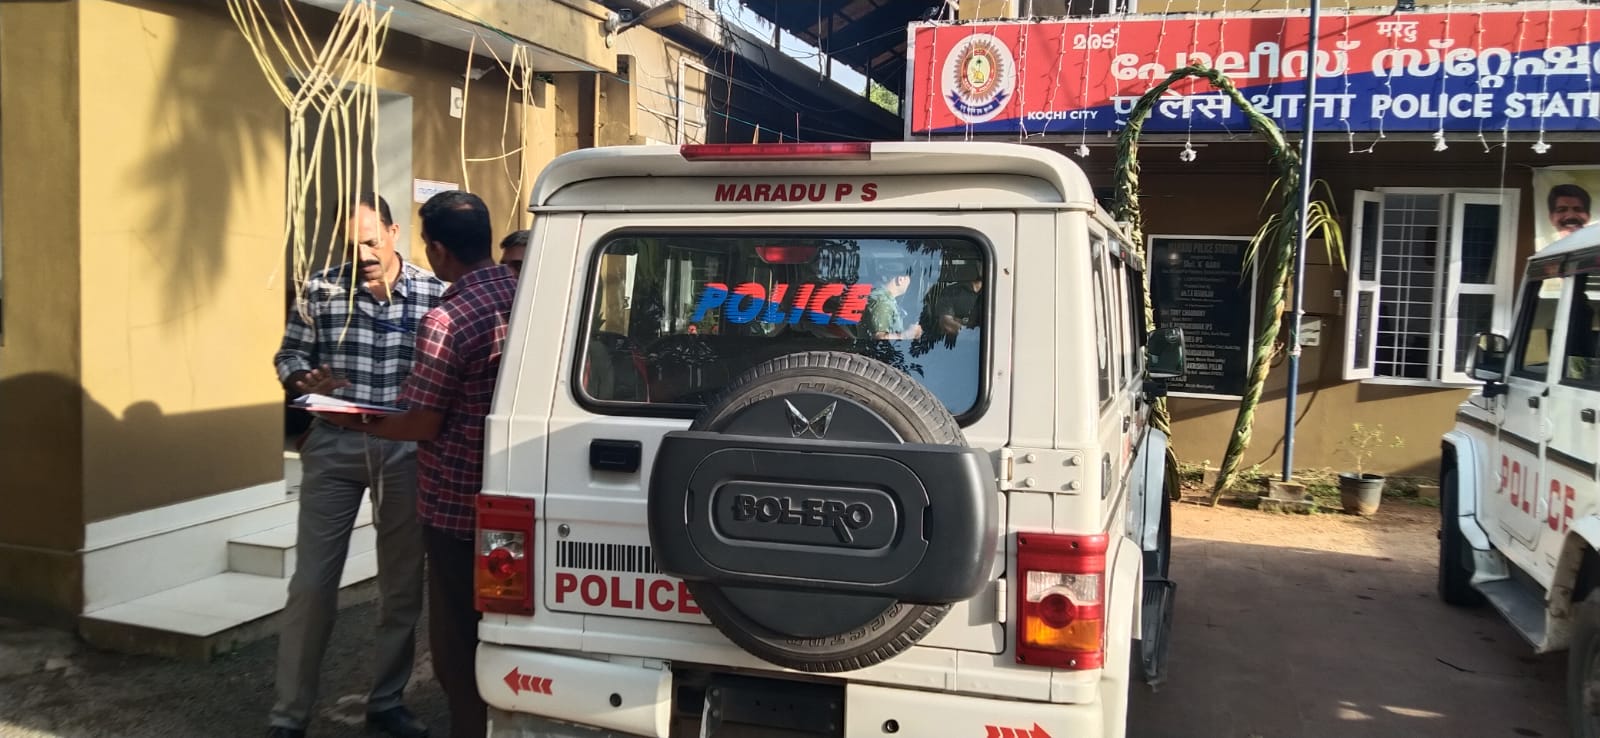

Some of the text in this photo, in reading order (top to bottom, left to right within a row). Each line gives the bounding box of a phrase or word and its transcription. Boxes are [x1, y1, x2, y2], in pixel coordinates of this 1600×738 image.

[1072, 29, 1119, 50] മരട്
[1376, 20, 1419, 43] मरदु
[1371, 38, 1600, 89] സ്റ്റേഷ
[1027, 109, 1099, 121] KOCHI CITY
[1371, 93, 1494, 119] POLICE
[714, 182, 878, 203] MARADU P S
[689, 282, 873, 325] POLICE
[1501, 454, 1576, 535] POLICE
[731, 493, 873, 544] BOLERO
[555, 572, 702, 615] POLICE
